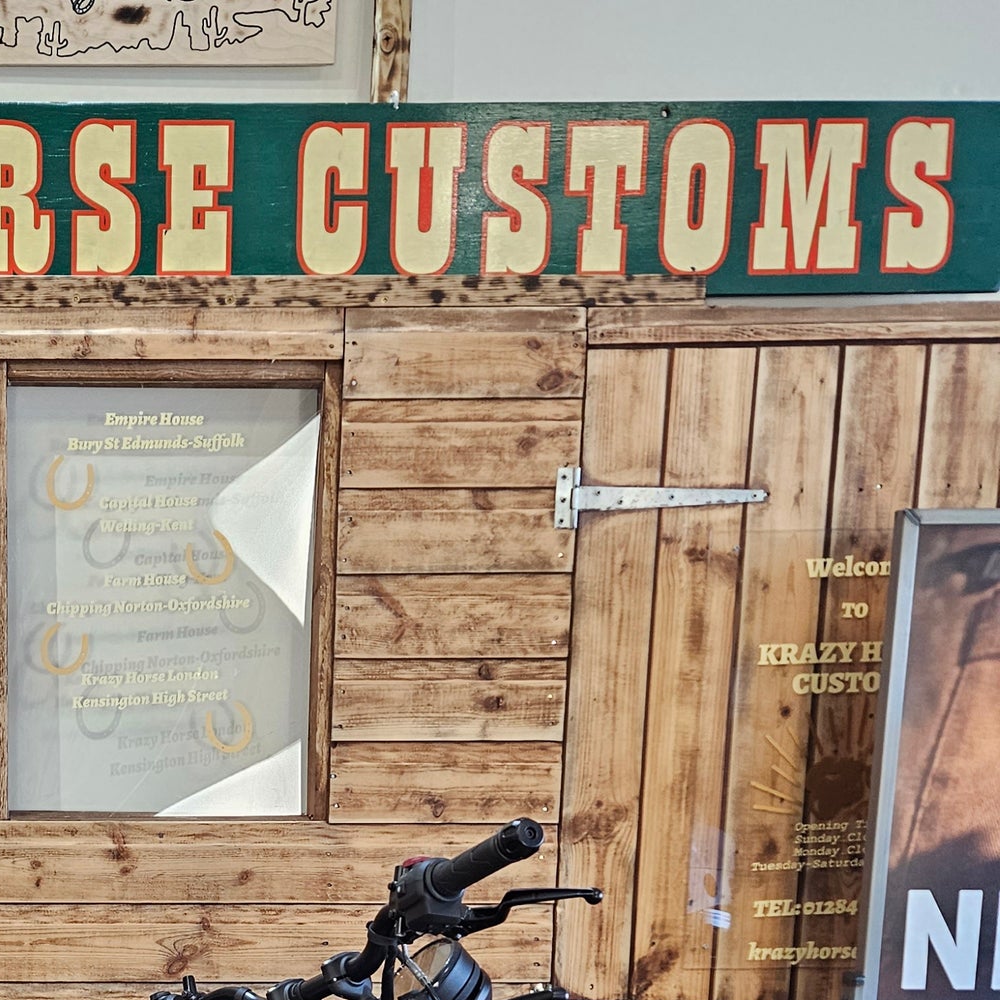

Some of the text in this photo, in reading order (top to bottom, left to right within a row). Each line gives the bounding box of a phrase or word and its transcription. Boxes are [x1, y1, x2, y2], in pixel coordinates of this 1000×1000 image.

[296, 116, 955, 275] CUSTOMS
[104, 411, 204, 428] Empire House
[67, 434, 245, 454] Bury St Edmunds-Suffolk
[99, 495, 197, 511] Capital House
[99, 518, 194, 535] Welling-Kent
[103, 573, 186, 588] Farm House
[46, 596, 250, 619] Chipping Norton-Oxfordshire
[841, 602, 869, 619] TO
[757, 641, 859, 666] KRAZY
[81, 668, 219, 689] Krazy Horse London
[72, 688, 229, 710] Kensington High Street
[794, 822, 849, 834] Opening
[794, 834, 841, 844] Sunday
[792, 847, 840, 857] Monday
[901, 888, 1000, 991] N
